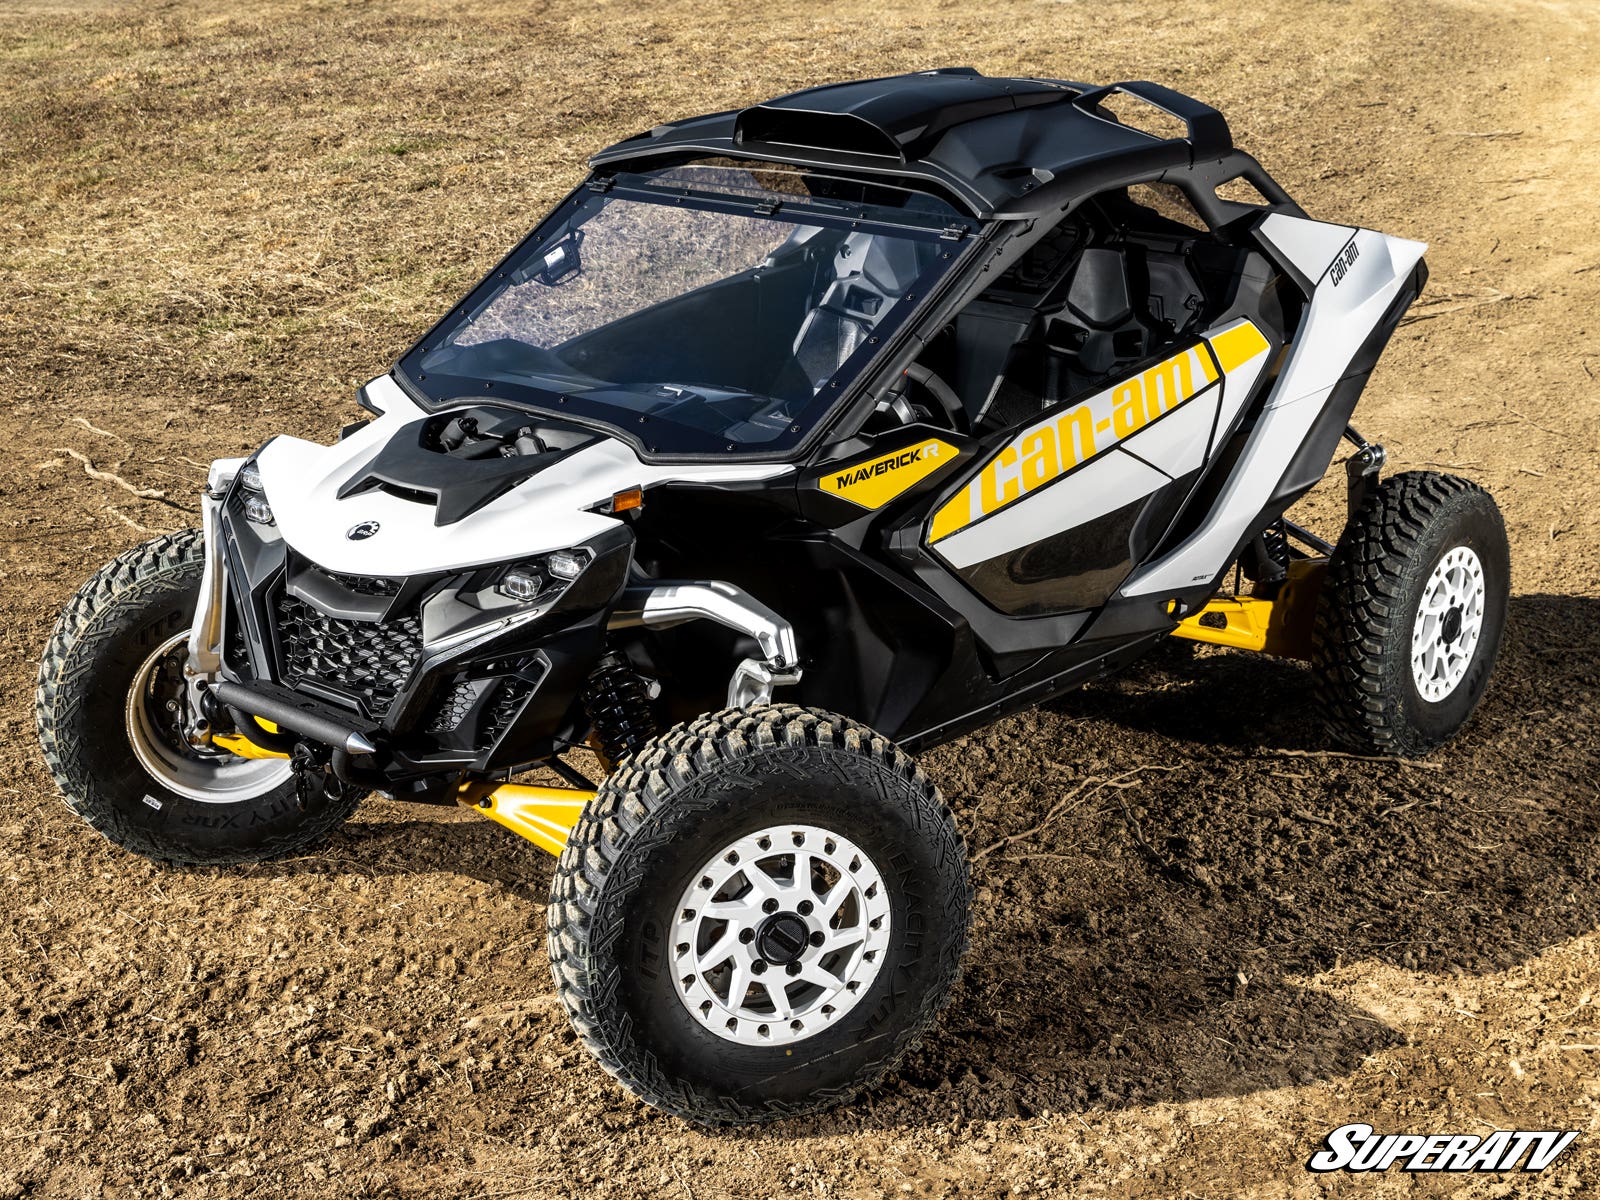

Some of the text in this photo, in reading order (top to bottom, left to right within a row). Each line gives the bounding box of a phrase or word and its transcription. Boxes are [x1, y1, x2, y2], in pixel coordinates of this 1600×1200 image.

[836, 443, 939, 490] MAVERICK R
[980, 349, 1195, 516] can-am
[880, 842, 927, 982] TENACITY
